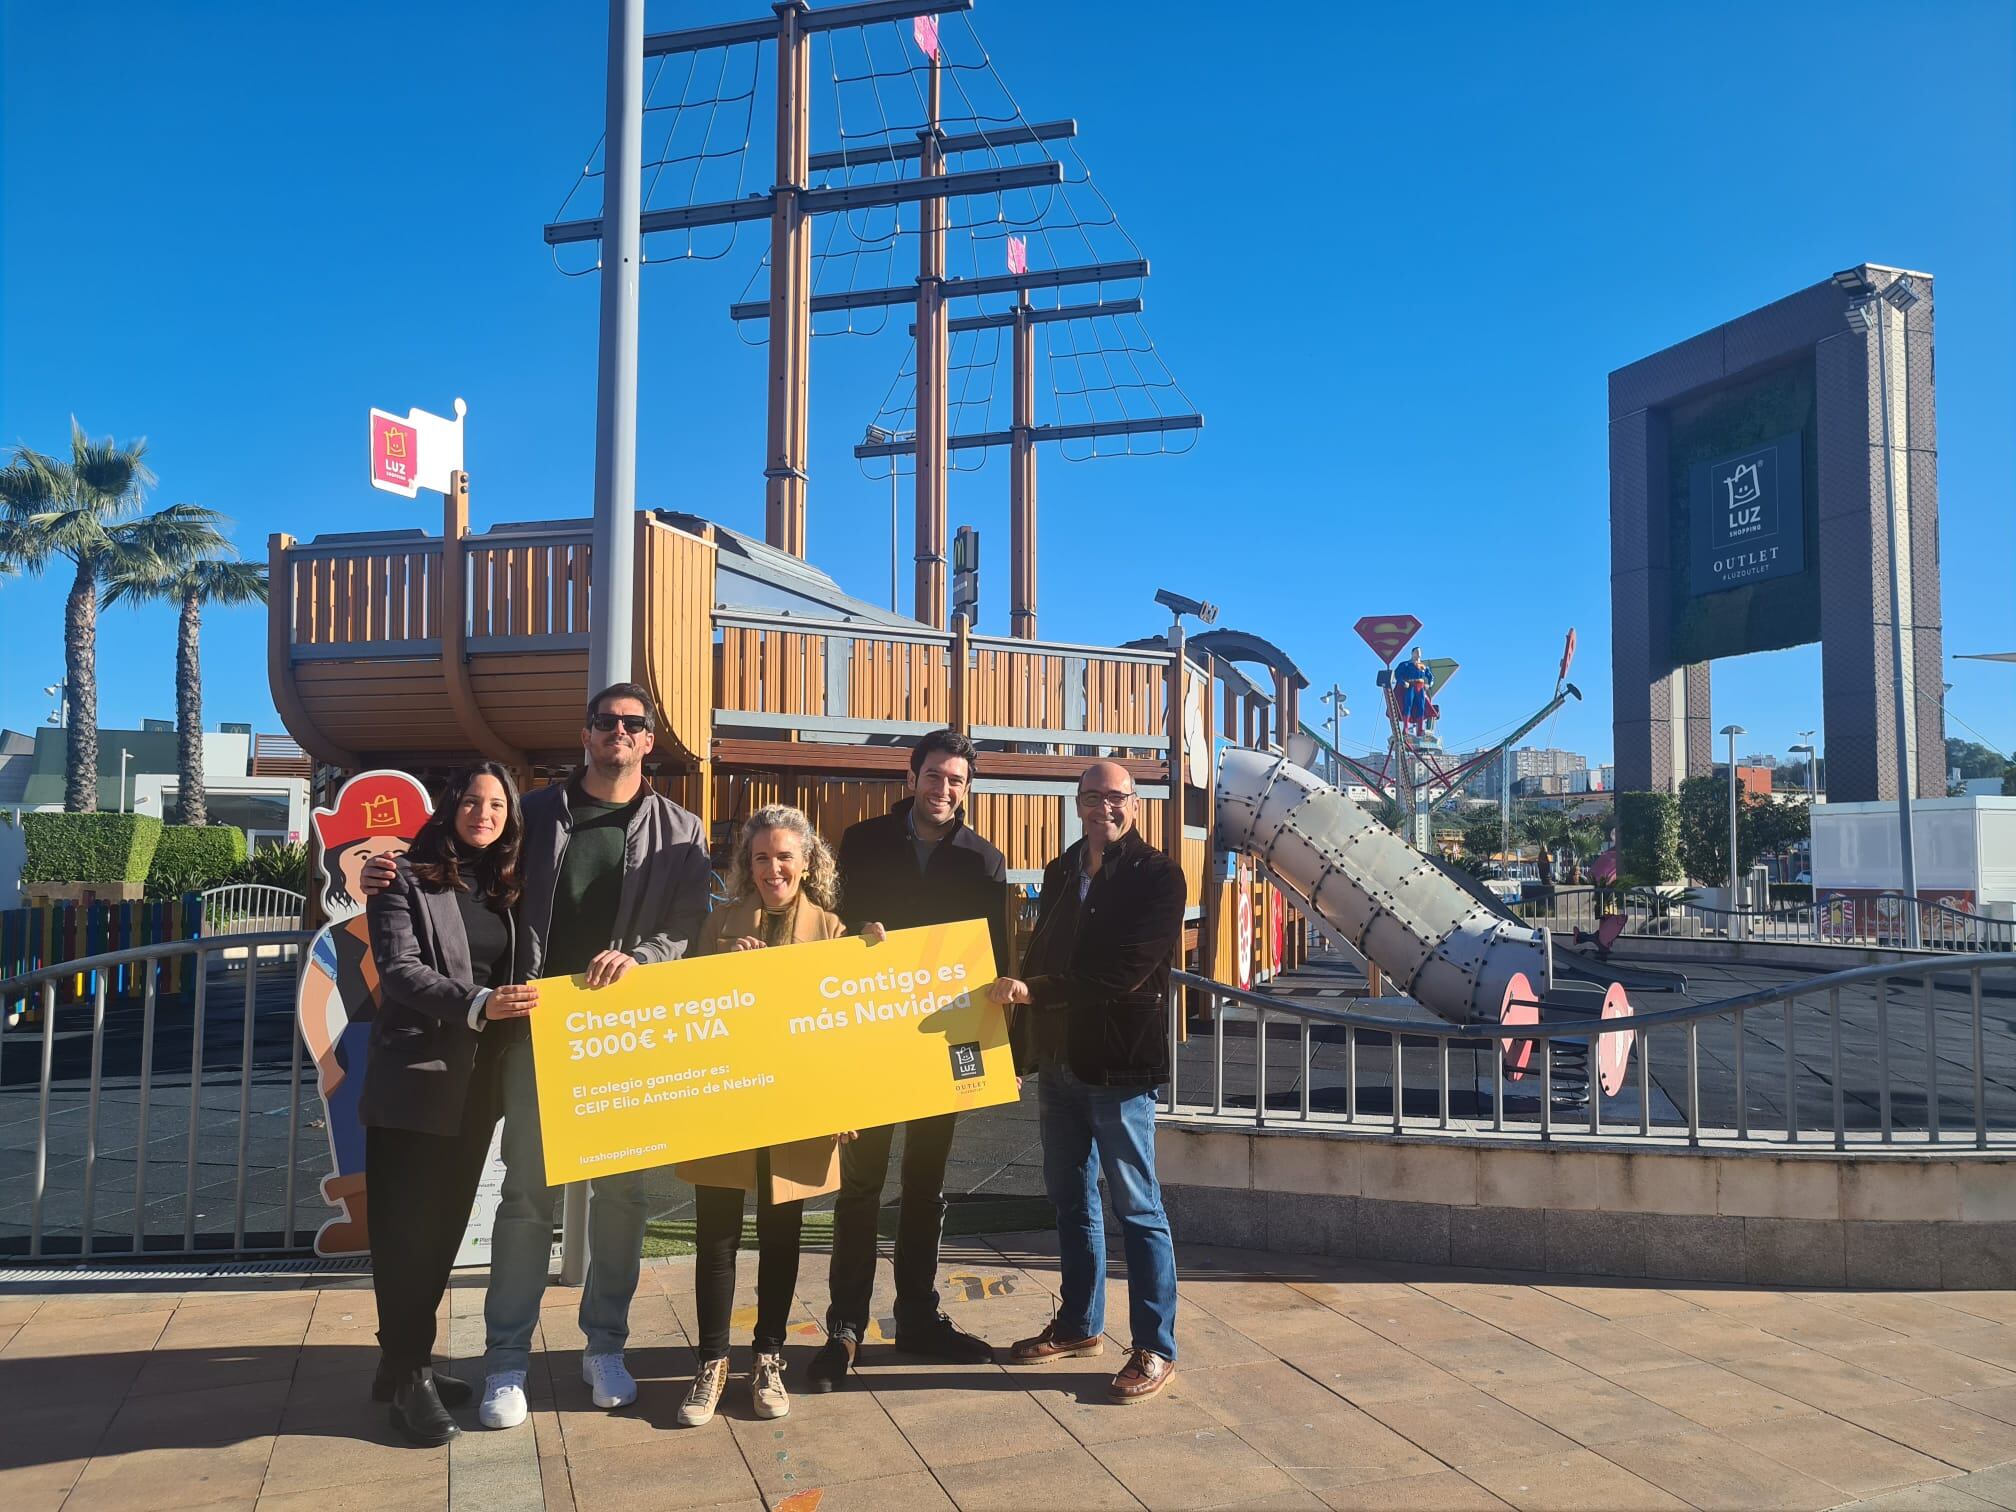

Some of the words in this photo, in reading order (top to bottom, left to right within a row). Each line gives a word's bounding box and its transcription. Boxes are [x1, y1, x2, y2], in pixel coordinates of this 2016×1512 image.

[385, 459, 406, 475] LUZ
[1729, 506, 1761, 529] LUZ
[1729, 524, 1761, 538] SHOPPING
[1713, 547, 1779, 573] OUTLET
[819, 967, 931, 999] Contigo
[937, 963, 966, 982] es
[565, 1004, 667, 1033] Cheque
[673, 988, 756, 1018] regalo
[789, 1007, 849, 1034] más
[854, 986, 971, 1025] Navidad
[568, 1028, 657, 1061] 3000€
[663, 1028, 679, 1043] +
[685, 1018, 729, 1042] IVA
[572, 1085, 587, 1098] El
[590, 1077, 643, 1096] colegio
[647, 1067, 707, 1089] ganador
[710, 1064, 730, 1075] es:
[960, 1064, 976, 1073] LUZ
[575, 1100, 610, 1116] CEIP
[613, 1094, 640, 1109] Elio
[643, 1086, 700, 1105] Antonio
[703, 1082, 721, 1095] de
[723, 1073, 775, 1090] Nebrija
[955, 1081, 987, 1091] OUTLET
[579, 1142, 667, 1165] luzshopping.com
